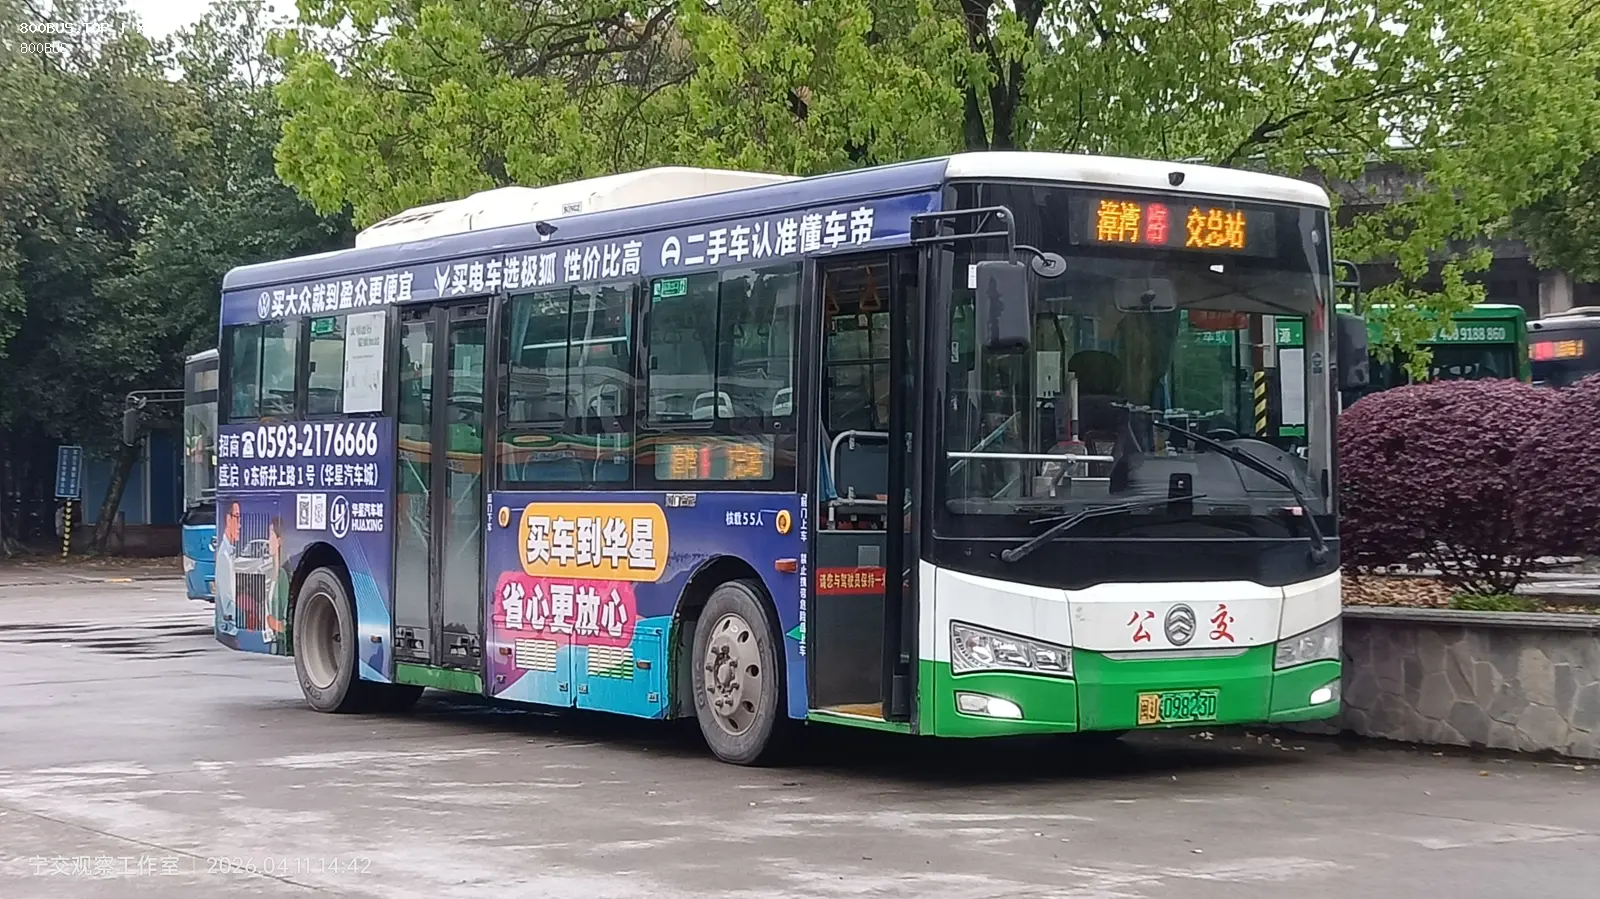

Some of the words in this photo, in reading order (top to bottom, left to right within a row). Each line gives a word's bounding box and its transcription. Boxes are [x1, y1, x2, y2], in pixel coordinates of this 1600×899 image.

[685, 206, 874, 265] 二手车认准懂车帝
[452, 252, 557, 295] 买电车选极狐
[564, 240, 642, 283] 性价比高
[271, 271, 414, 318] 买大众就到盈众更便宜
[1460, 327, 1485, 340] 9188
[219, 433, 240, 457] 招商
[257, 422, 378, 458] 0593-2176666
[352, 518, 383, 532] HUAXING
[726, 511, 764, 526] 核载55人
[800, 493, 808, 542] 前门上车
[526, 514, 657, 570] 买车到华星
[502, 582, 629, 637] 省心更放心
[1127, 611, 1155, 643] 公
[1209, 604, 1235, 643] 交
